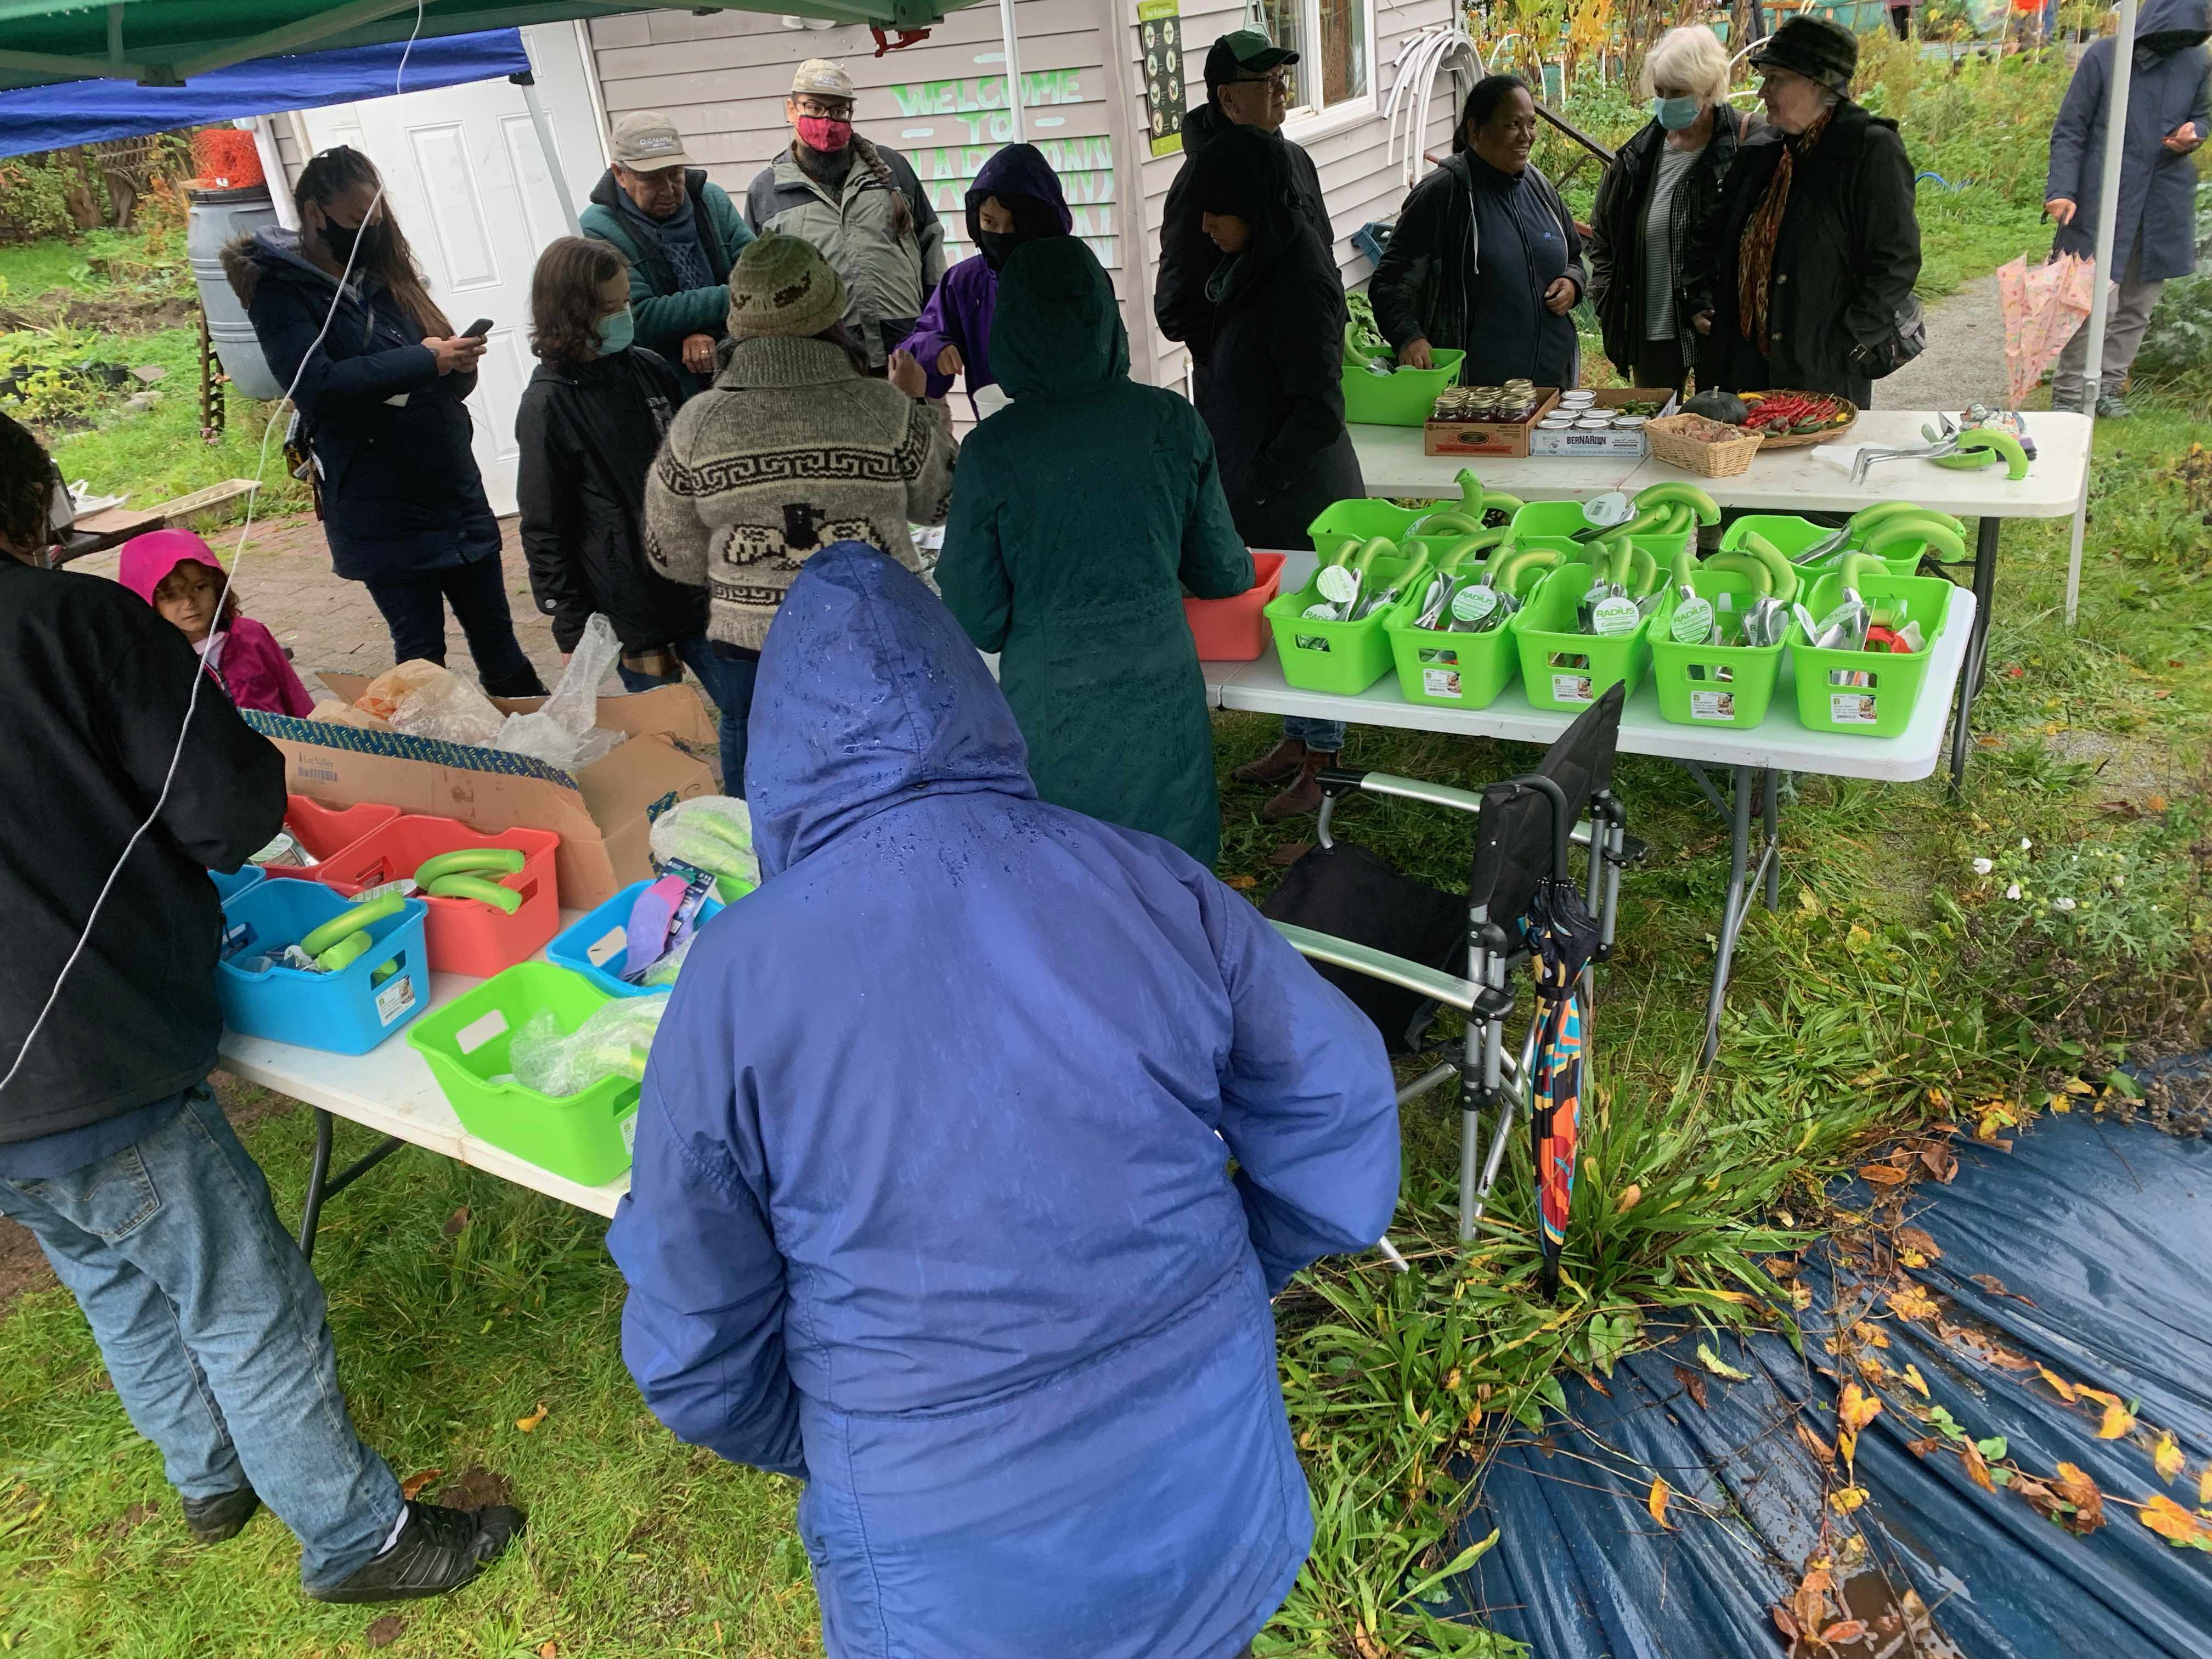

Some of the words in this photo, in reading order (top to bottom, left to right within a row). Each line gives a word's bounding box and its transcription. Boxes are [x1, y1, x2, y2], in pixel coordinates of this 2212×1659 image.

[890, 69, 1084, 117] WELCOME
[956, 112, 1015, 145] TO
[1460, 591, 1493, 605] RADIUS
[1596, 607, 1635, 617] RADIUS
[1674, 604, 1708, 624] RADIUS
[1674, 616, 1711, 632] Transplanter
